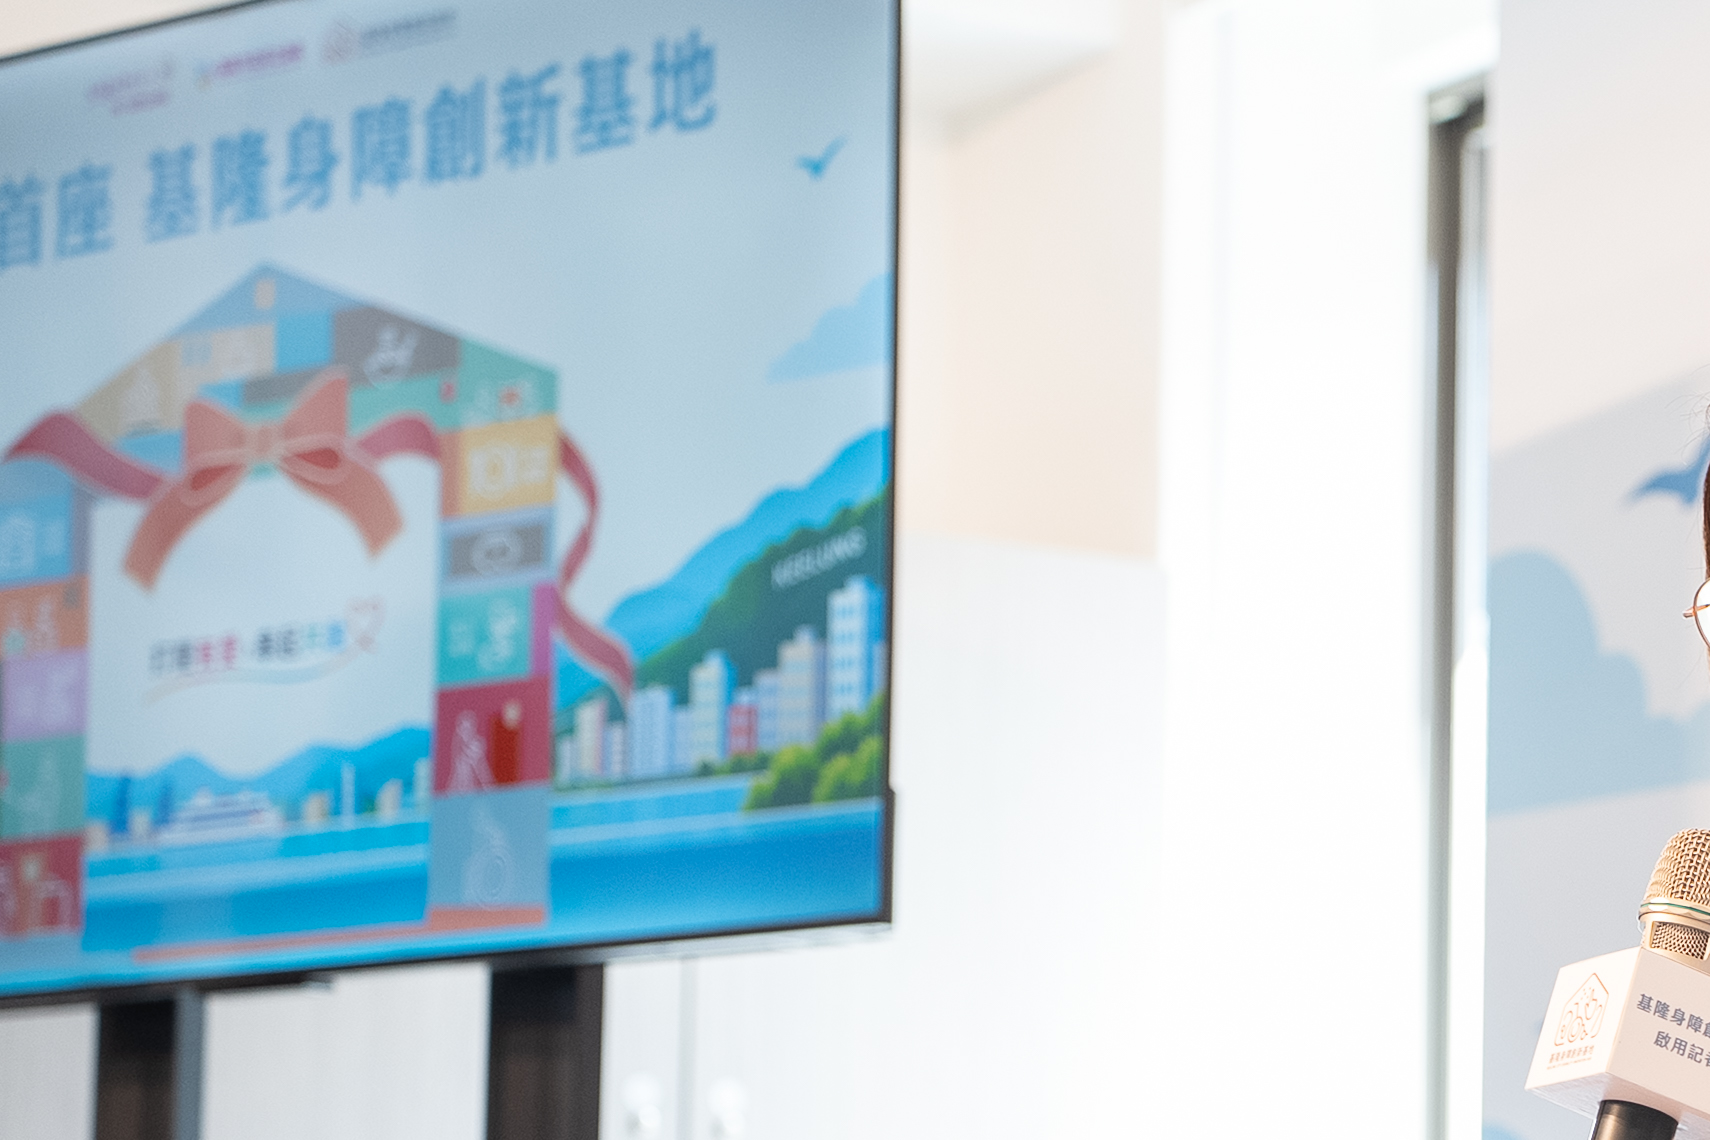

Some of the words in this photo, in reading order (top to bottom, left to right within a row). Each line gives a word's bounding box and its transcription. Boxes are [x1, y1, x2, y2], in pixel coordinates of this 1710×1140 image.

[146, 28, 718, 244] 基隆身障創新基地
